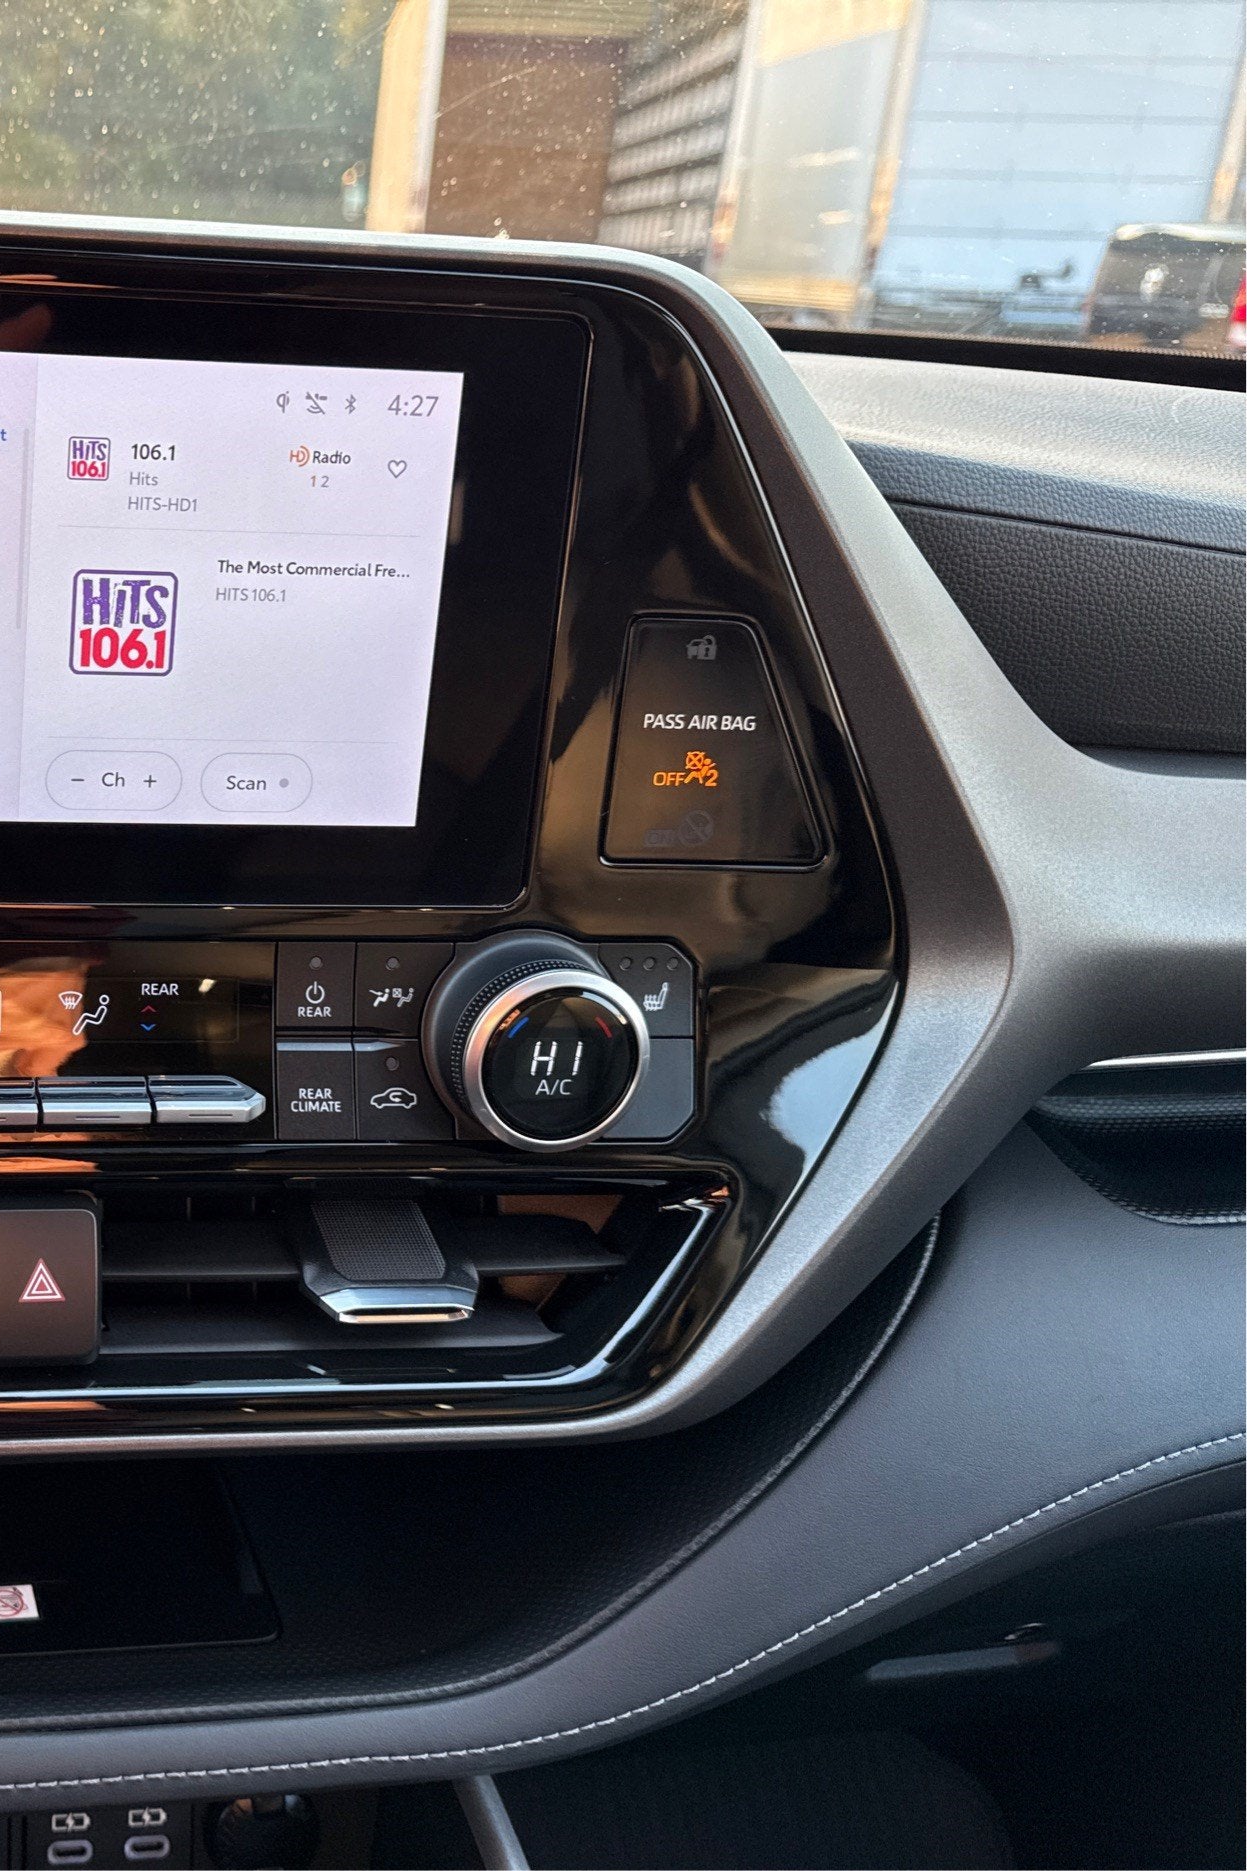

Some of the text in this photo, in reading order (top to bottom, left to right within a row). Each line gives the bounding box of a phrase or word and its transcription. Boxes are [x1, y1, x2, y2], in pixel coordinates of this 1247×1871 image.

[387, 394, 439, 417] 4:27
[131, 443, 176, 461] 106.1
[312, 450, 351, 465] Radio
[71, 460, 106, 477] 106.1
[129, 472, 159, 486] Hits
[310, 475, 330, 488] 1 2
[127, 496, 198, 512] HITS-HD1
[217, 560, 243, 575] The
[247, 560, 282, 575] Most
[286, 562, 372, 578] Commercial
[216, 587, 286, 602] HITS 106.1
[79, 627, 167, 669] 106.1
[643, 713, 757, 731] PASS AIR BAG
[101, 772, 126, 788] Ch
[226, 775, 267, 791] Scan
[653, 769, 719, 787] OFF 2
[141, 983, 179, 996] REAR
[297, 1006, 331, 1018] REAR
[530, 1041, 583, 1076] HI
[299, 1088, 333, 1100] REAR
[535, 1079, 572, 1096] A/C
[290, 1100, 342, 1113] CLIMATE
